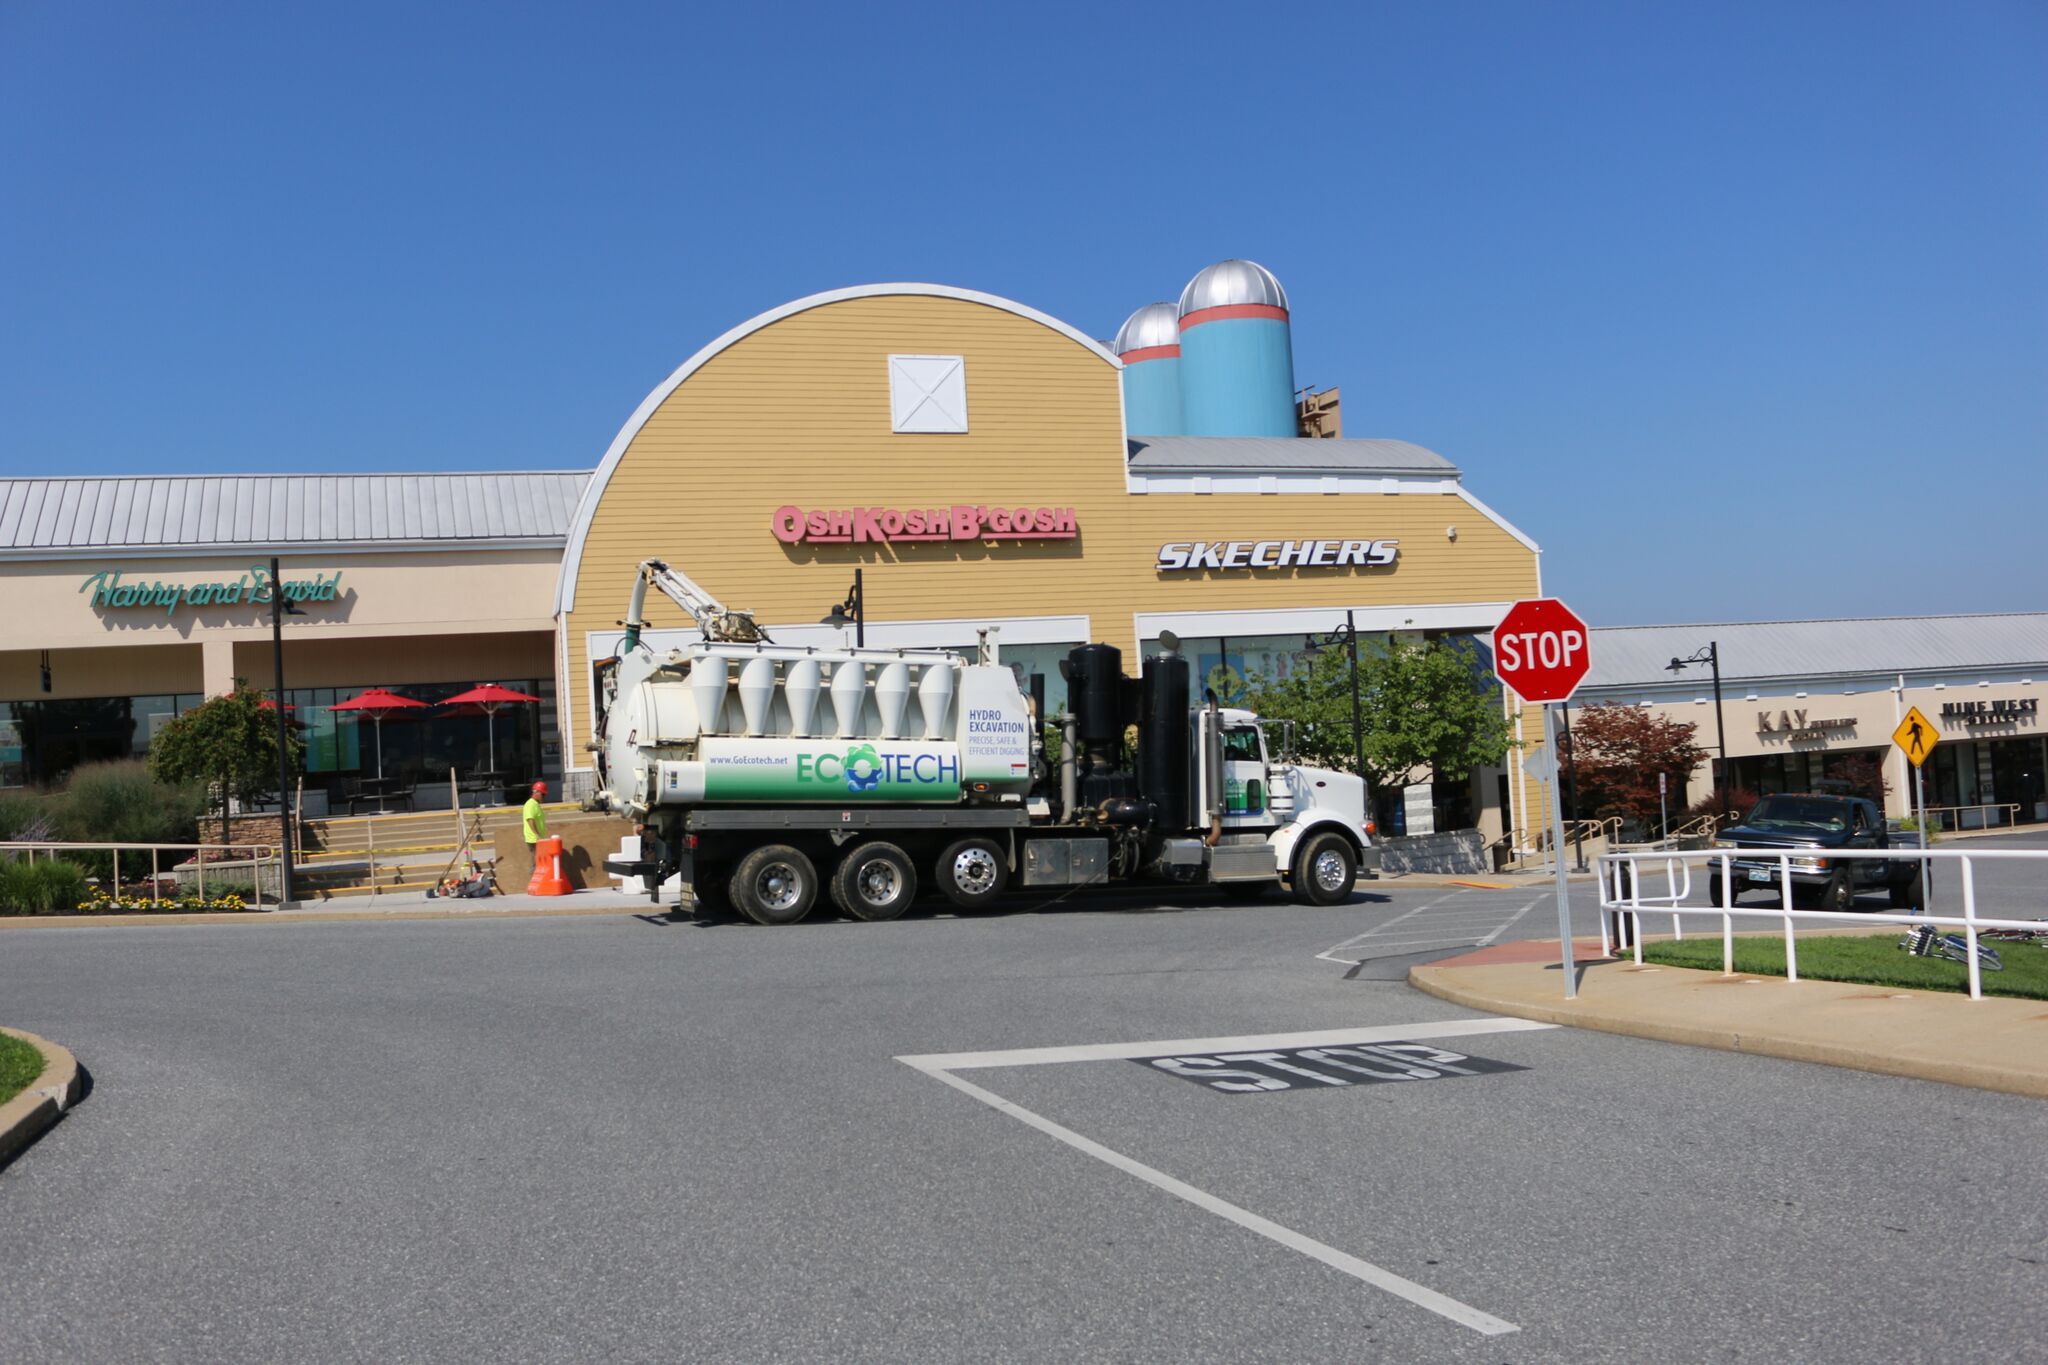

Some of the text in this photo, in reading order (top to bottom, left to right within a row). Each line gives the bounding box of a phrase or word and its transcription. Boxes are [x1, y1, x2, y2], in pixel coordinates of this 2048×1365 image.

[1155, 539, 1400, 571] SKECHERS
[79, 565, 343, 617] Harry and David
[1501, 629, 1583, 672] STOP
[969, 709, 1001, 720] HYDRO
[1942, 698, 2040, 716] NINE WEST
[969, 721, 1024, 733] EXCAVATION
[1757, 708, 1808, 732] KAY
[997, 735, 1010, 745] SAFE
[709, 755, 788, 765] www.GoEcotech.net
[968, 746, 1024, 756] EFFICIENT DIGGING
[1151, 1044, 1482, 1092] STOP
